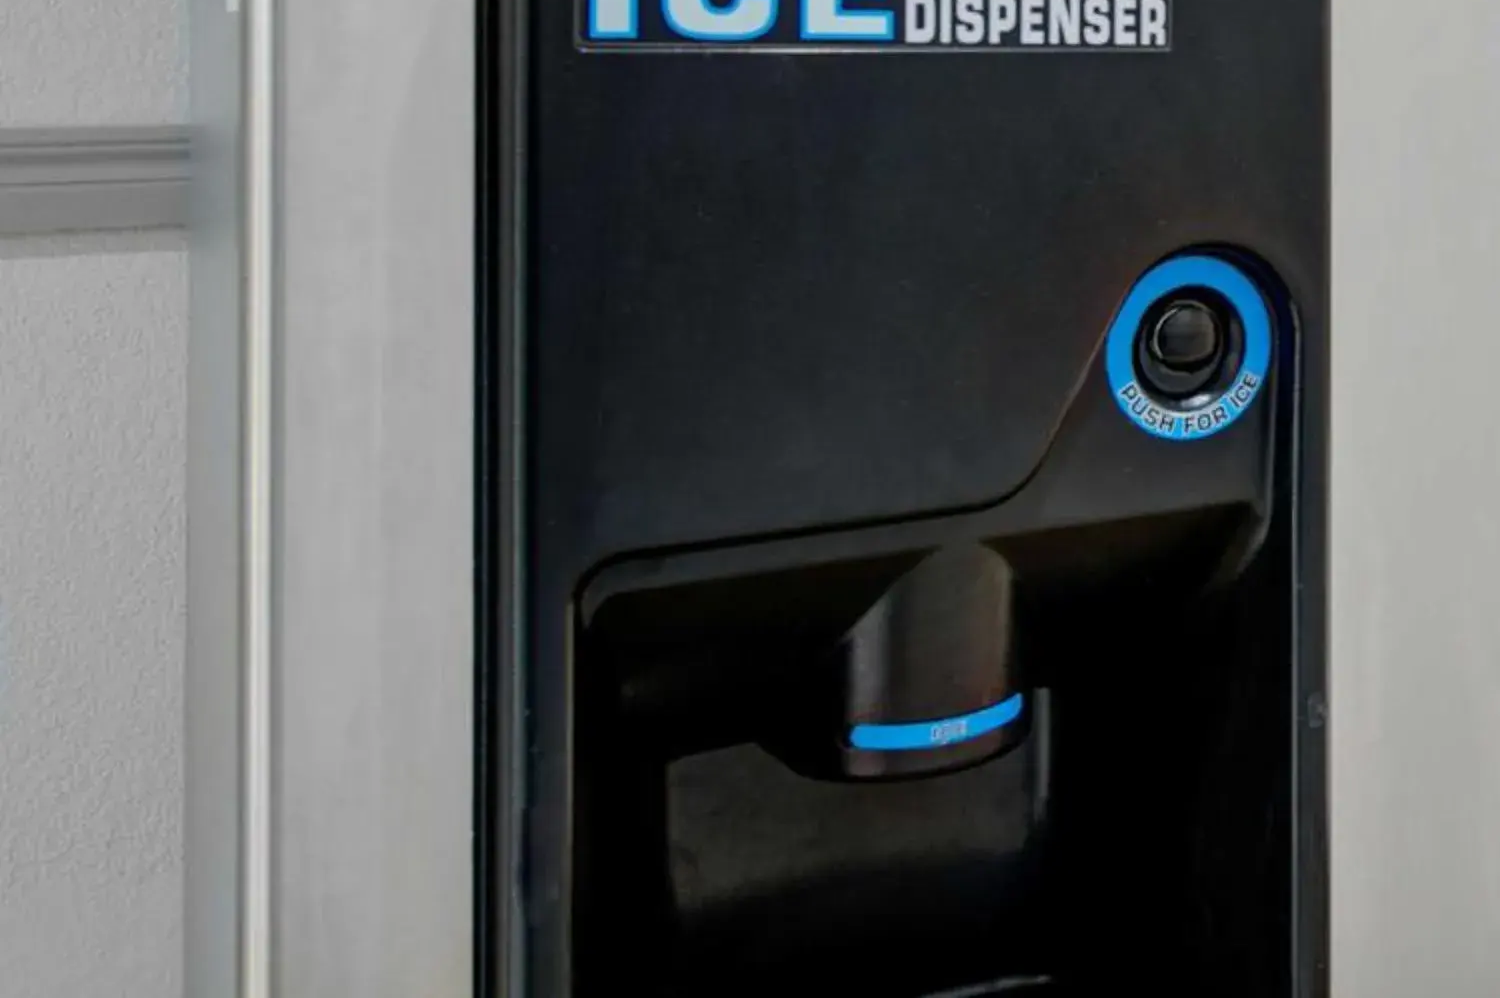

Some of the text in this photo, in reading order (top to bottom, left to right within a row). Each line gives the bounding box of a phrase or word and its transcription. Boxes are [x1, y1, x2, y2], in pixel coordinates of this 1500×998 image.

[1120, 373, 1259, 433] PUSH FOR ICE
